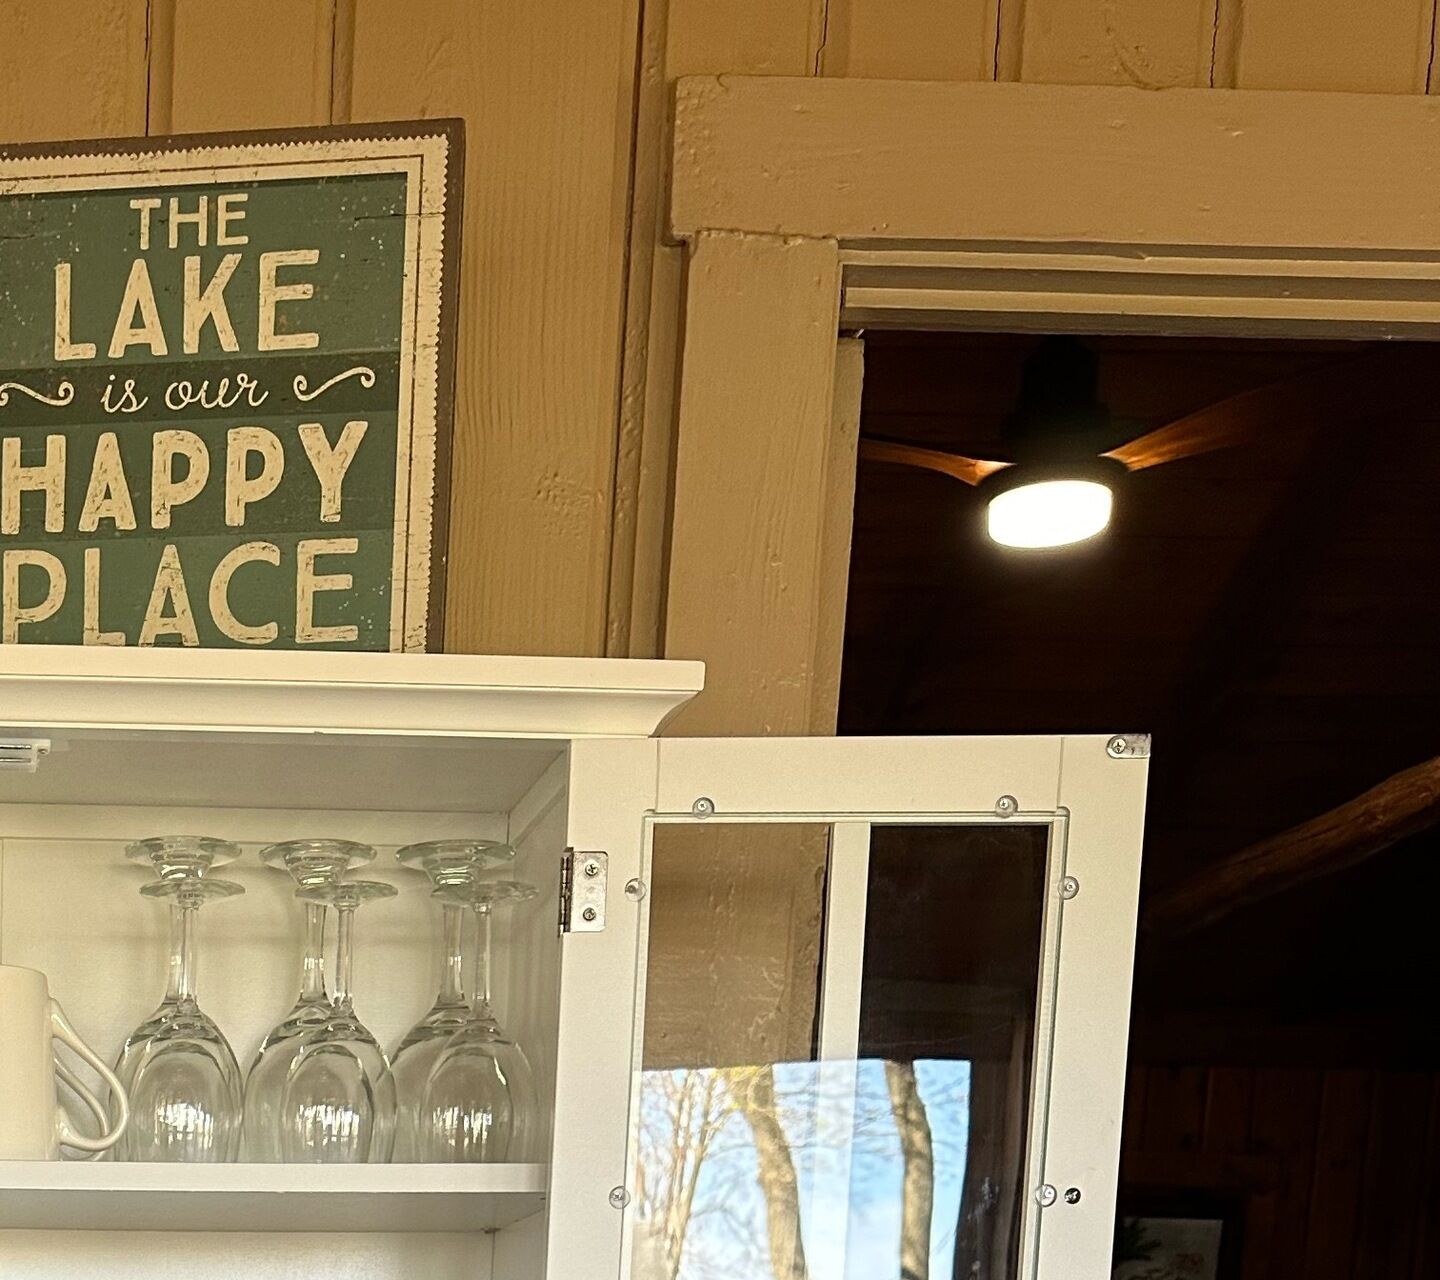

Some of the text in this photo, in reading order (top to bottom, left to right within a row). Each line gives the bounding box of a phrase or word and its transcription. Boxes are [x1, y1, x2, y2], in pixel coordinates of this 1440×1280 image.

[129, 193, 250, 250] THE
[54, 249, 320, 360] LAKE
[100, 371, 269, 413] is our
[0, 421, 369, 535] HAPPY
[2, 538, 359, 647] PLACE
